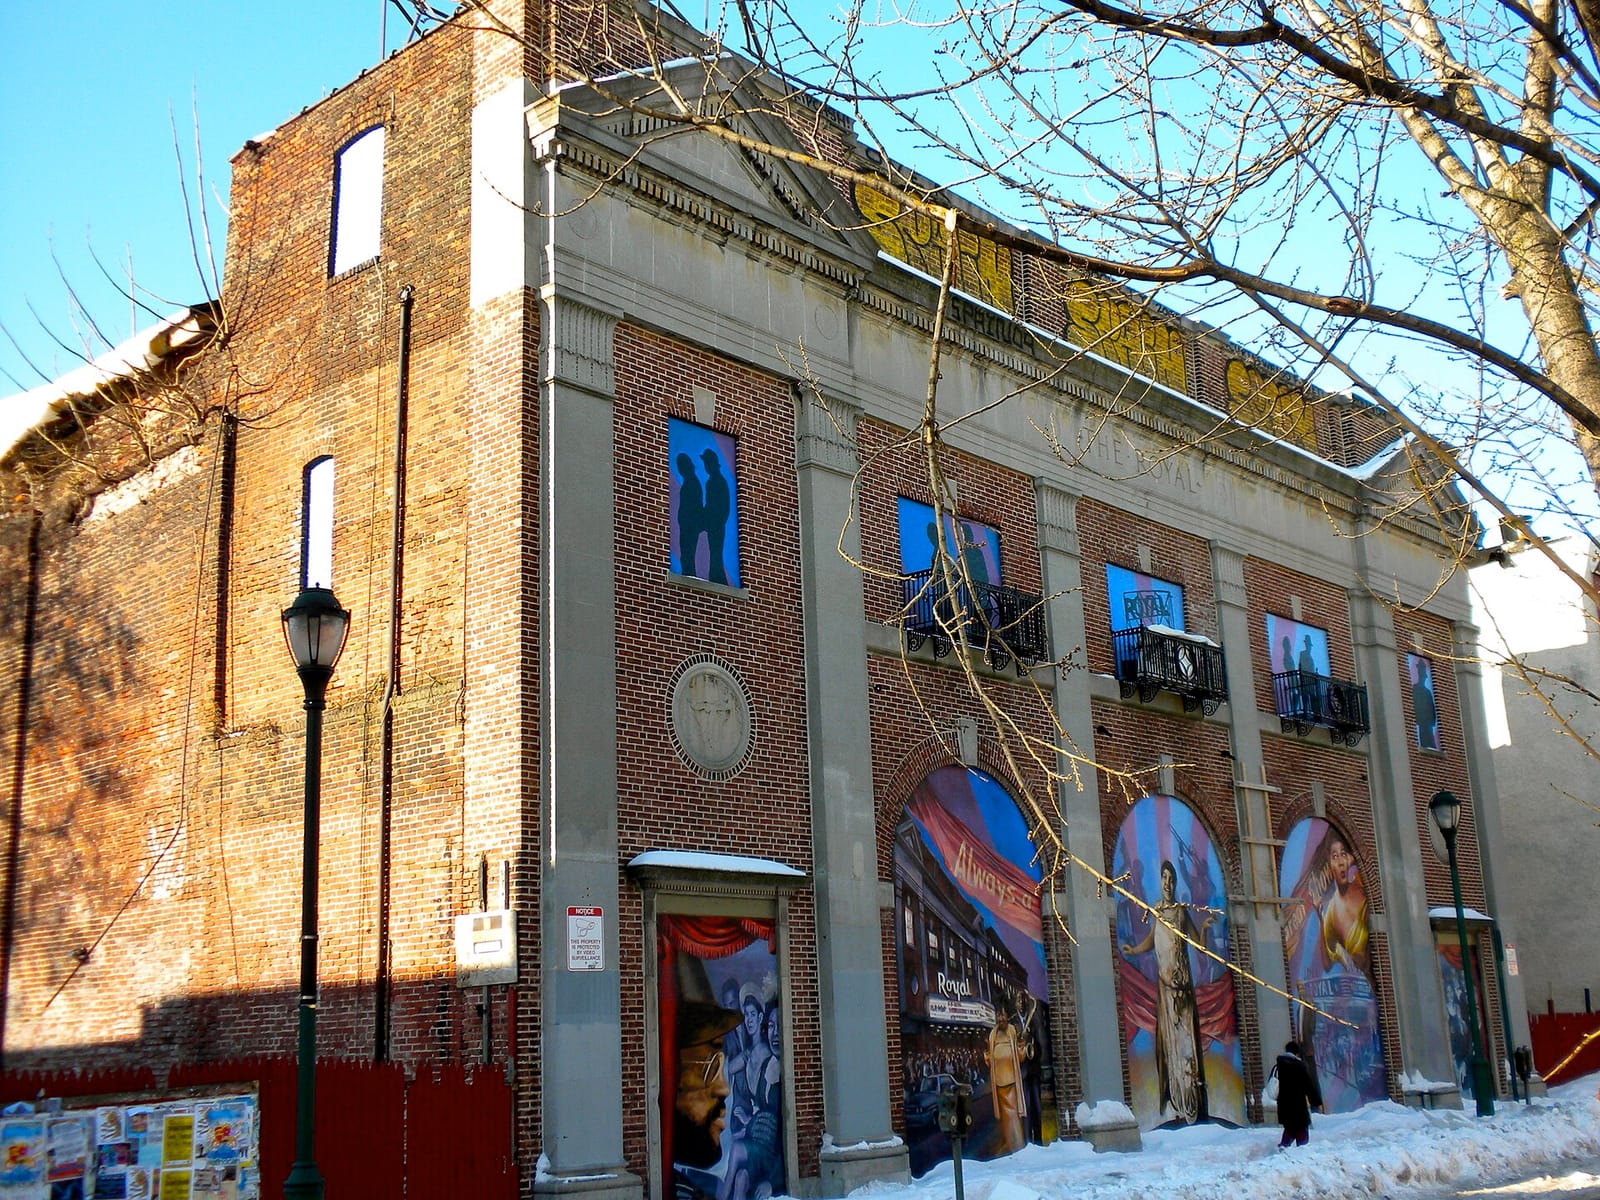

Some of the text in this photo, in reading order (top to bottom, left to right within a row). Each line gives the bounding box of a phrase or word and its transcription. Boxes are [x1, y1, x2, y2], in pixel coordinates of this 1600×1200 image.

[1082, 426, 1124, 466] THE
[954, 840, 1034, 910] Always a
[575, 908, 595, 916] NOTICE
[937, 971, 973, 1002] Royal
